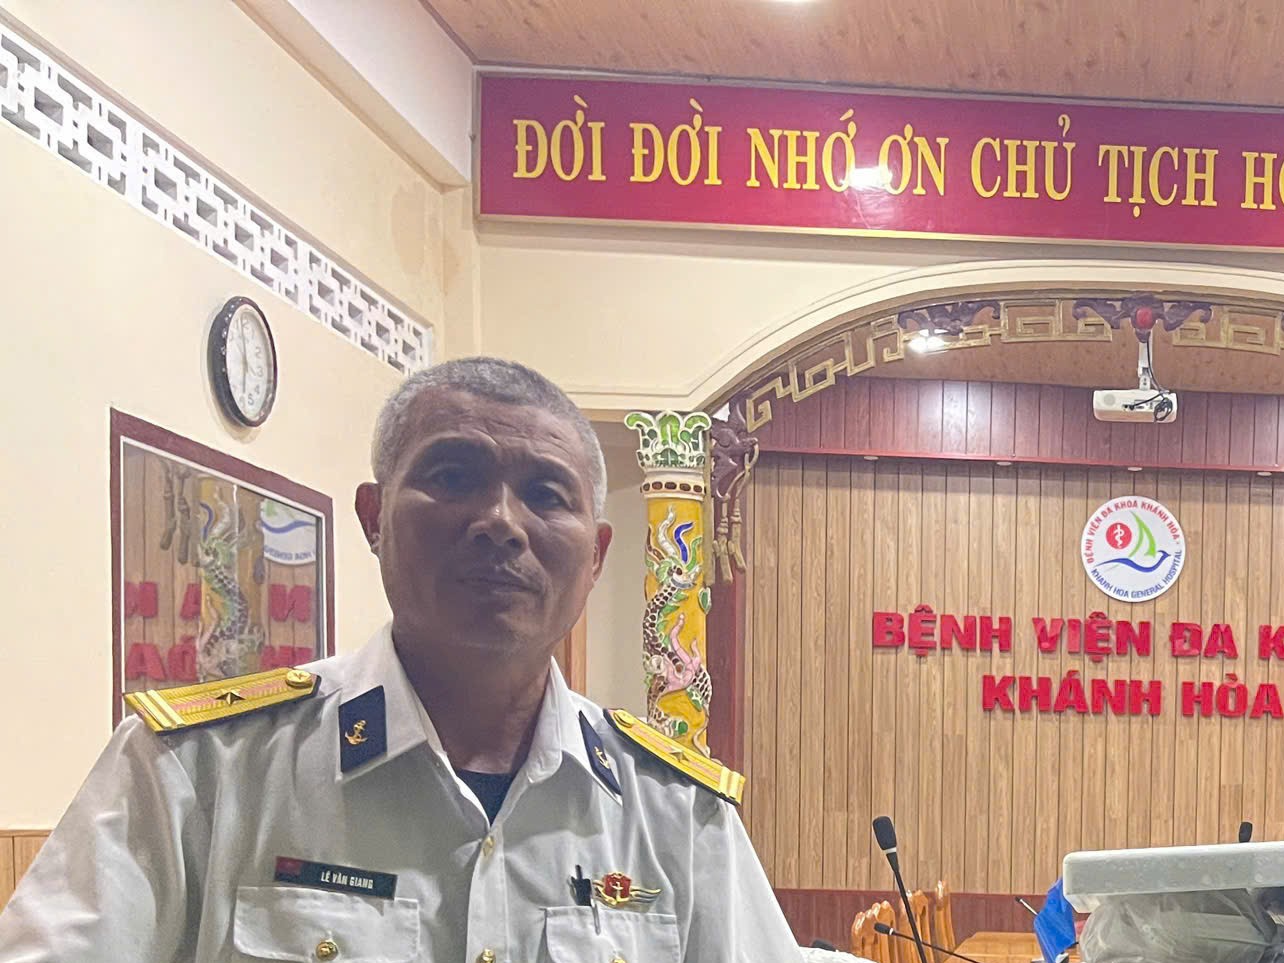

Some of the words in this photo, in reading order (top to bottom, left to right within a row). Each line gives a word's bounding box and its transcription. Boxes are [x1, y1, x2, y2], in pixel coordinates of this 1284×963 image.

[514, 95, 606, 181] ĐỜI
[630, 98, 722, 186] ĐỜI
[747, 110, 857, 192] NHỚ
[879, 125, 949, 195] ƠN
[971, 114, 1075, 201] CHỦ
[1099, 145, 1218, 217] TỊCH
[1114, 500, 1138, 512] KHOA
[1091, 568, 1113, 592] KHANH
[1112, 586, 1129, 599] HOA
[1131, 583, 1165, 599] GENERAL
[1162, 549, 1183, 585] HOSPITAL
[873, 604, 1013, 657] BỆNH
[1032, 611, 1152, 661] VIỆN
[1169, 622, 1239, 659] ĐA
[981, 669, 1163, 716] KHÁNH
[1180, 672, 1284, 720] HÒA
[350, 876, 374, 889] GIANG
